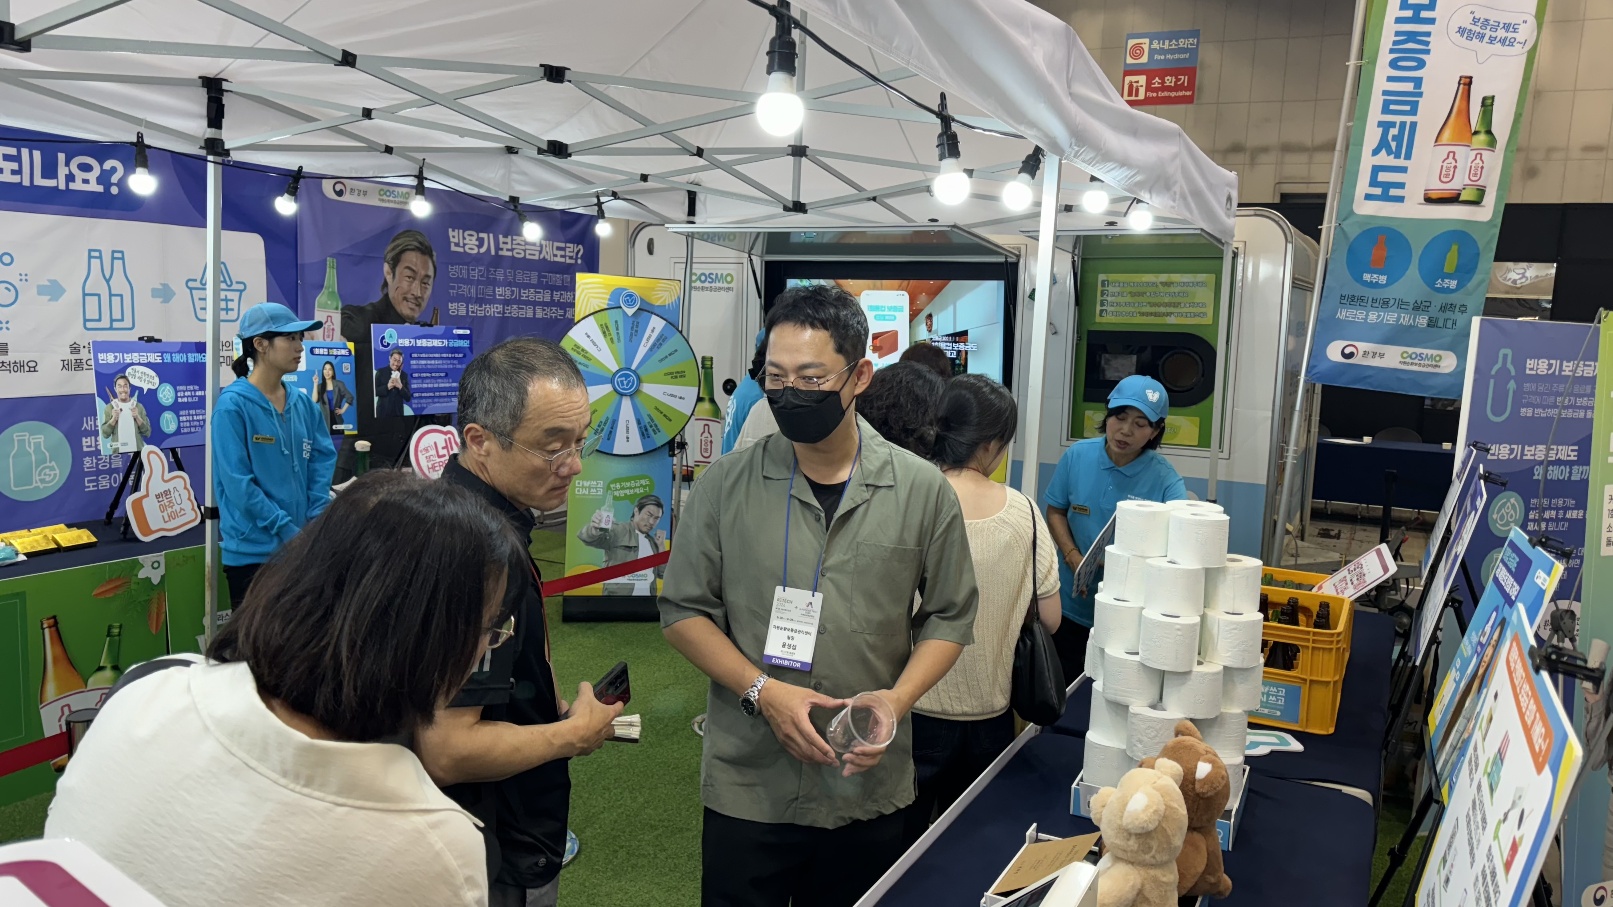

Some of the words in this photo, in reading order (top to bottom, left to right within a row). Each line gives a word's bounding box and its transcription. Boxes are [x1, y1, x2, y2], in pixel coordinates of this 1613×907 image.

[1151, 38, 1197, 50] 옥내소화전
[1455, 26, 1486, 43] 체험해
[1486, 35, 1527, 49] 보세요~!
[1443, 162, 1453, 179] 130원
[378, 188, 410, 199] COSMO
[448, 228, 495, 256] 빈용기
[498, 234, 584, 264] 보증금제도란?
[448, 265, 468, 278] 병에
[469, 266, 487, 280] 담긴
[489, 268, 505, 282] 주류
[515, 270, 538, 284] 음료를
[691, 272, 734, 285] COSMO
[1362, 273, 1387, 284] 맥주병
[1435, 278, 1458, 289] 소주병
[448, 283, 476, 298] 규격에
[495, 286, 519, 300] 빈용기
[520, 288, 551, 302] 보증금을
[552, 290, 575, 303] 부과하
[448, 302, 467, 316] 병을
[469, 303, 503, 317] 반납하면
[504, 305, 534, 318] 보증금을
[535, 306, 564, 319] 돌려주는
[1339, 293, 1369, 308] 반환된
[1371, 296, 1410, 311] 빈용기는
[1412, 300, 1432, 312] 살균
[1438, 302, 1456, 315] 세척
[1457, 304, 1468, 315] 후
[1336, 308, 1365, 322] 새로운
[1367, 311, 1397, 324] 용기로
[398, 338, 416, 347] 빈용기
[98, 352, 122, 363] 빈용기
[124, 353, 161, 363] 보증금제도
[1362, 350, 1386, 359] 환경부
[1400, 350, 1442, 363] COSMO
[1525, 358, 1560, 376] 빈용기
[1576, 397, 1595, 406] 보증금
[1520, 407, 1533, 417] 병을
[1487, 443, 1522, 460] 빈용기
[1523, 444, 1578, 461] 보증금제도
[83, 454, 123, 471] 환경을
[1546, 465, 1570, 480] 해야
[85, 473, 123, 491] 도움이
[155, 488, 172, 503] 반환
[158, 501, 175, 514] 아주
[1550, 498, 1575, 508] 빈용기는
[162, 507, 186, 524] 나이스
[1557, 510, 1564, 519] 후
[1565, 509, 1583, 519] 새로운
[771, 658, 801, 669] EXHIBITOR
